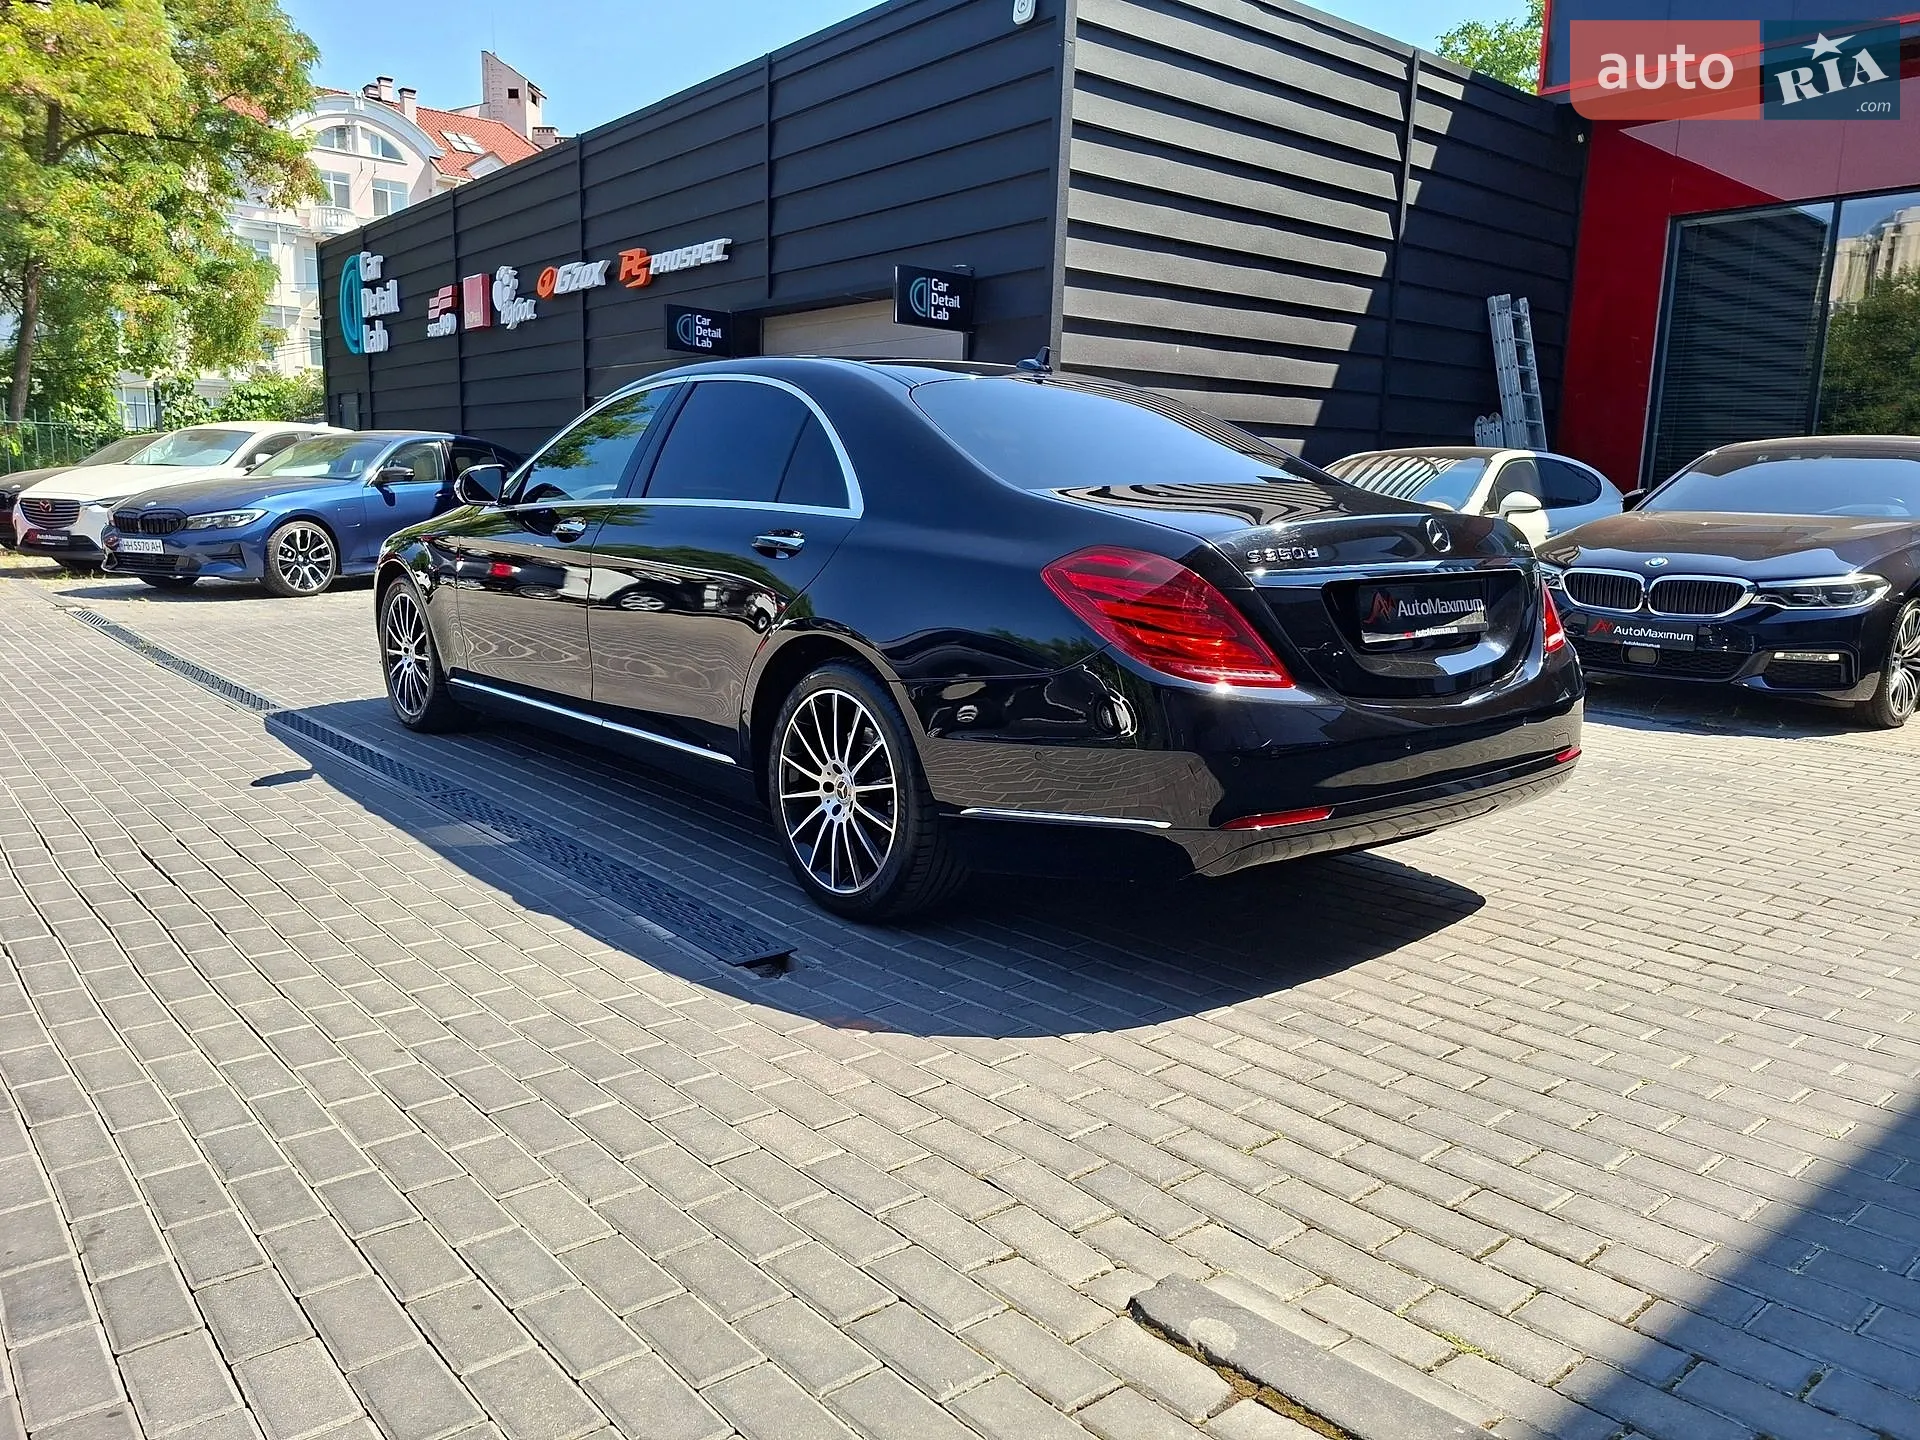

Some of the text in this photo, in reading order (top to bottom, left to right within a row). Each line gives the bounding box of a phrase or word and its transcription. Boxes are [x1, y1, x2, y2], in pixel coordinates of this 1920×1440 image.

[650, 238, 732, 275] PROSPEC
[359, 251, 384, 282] Car
[931, 278, 949, 292] Car
[361, 279, 400, 318] Detail
[931, 292, 960, 309] Detail
[695, 314, 712, 326] Car
[931, 306, 949, 320] Lab
[362, 320, 389, 354] Lab
[695, 325, 722, 339] Detail
[695, 336, 713, 349] Lab
[1397, 598, 1484, 618] AutoMaximum
[1613, 625, 1694, 641] AutoMaximum
